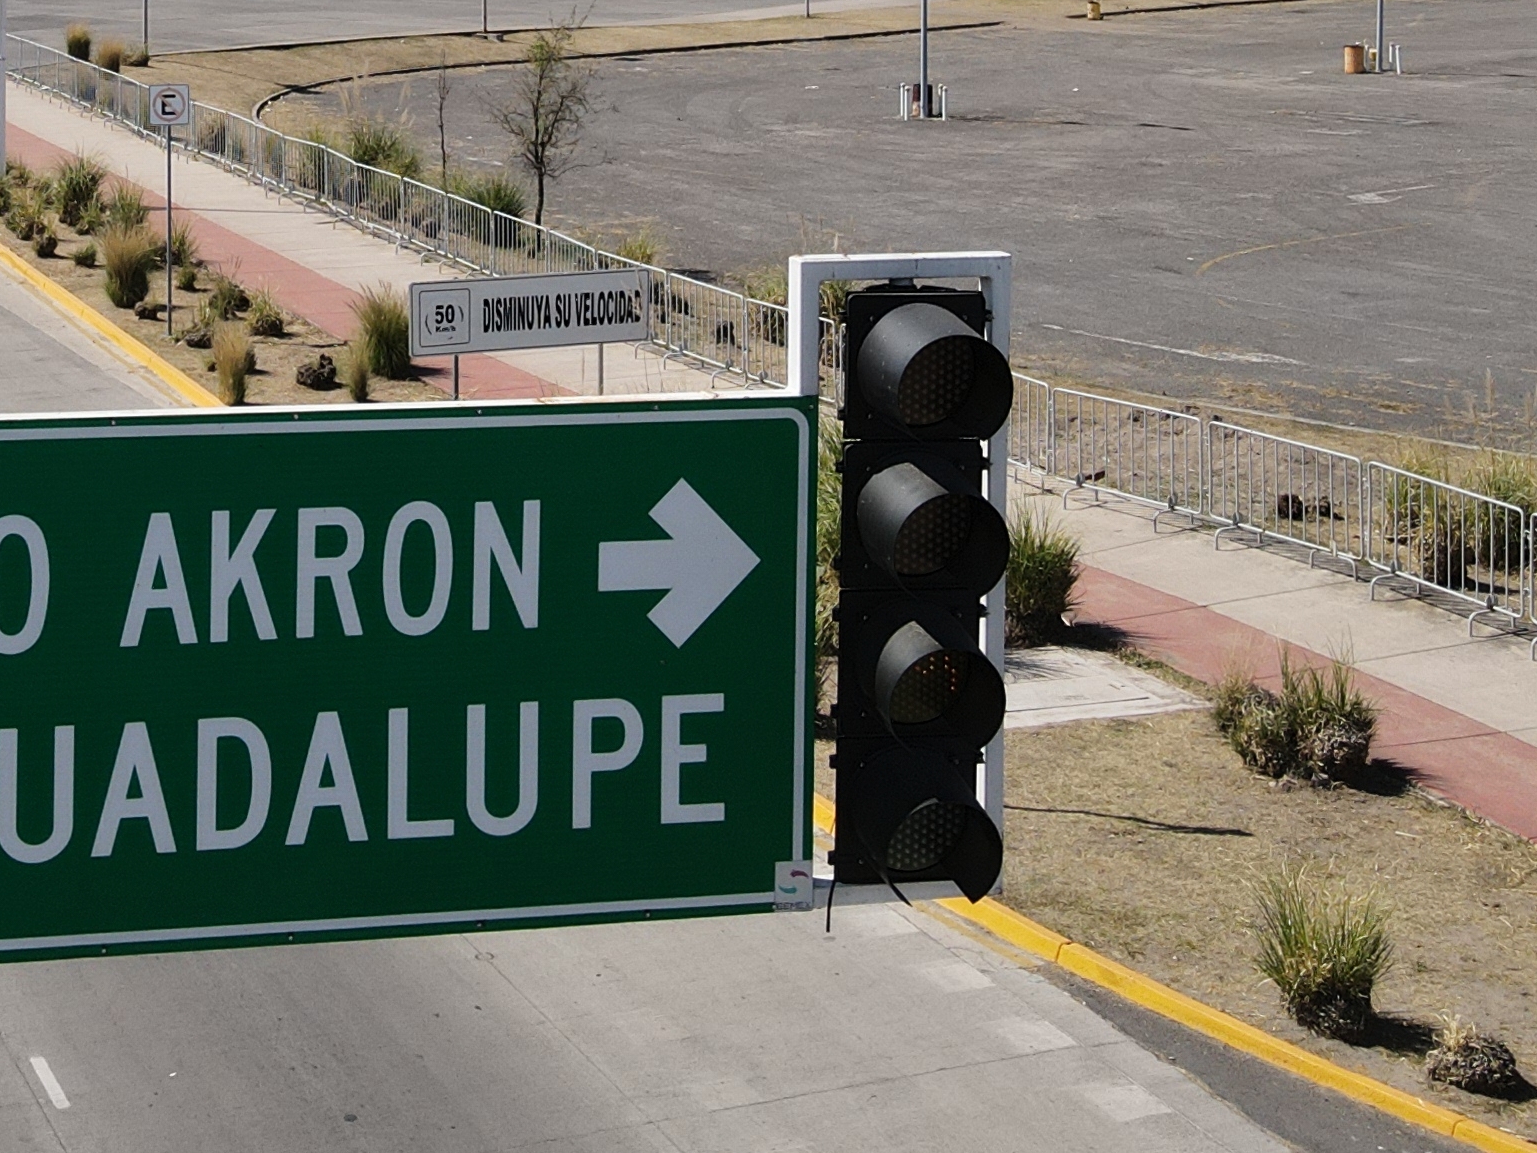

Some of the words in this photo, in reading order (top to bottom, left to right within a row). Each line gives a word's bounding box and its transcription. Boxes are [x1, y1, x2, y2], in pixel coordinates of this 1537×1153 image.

[435, 304, 455, 324] 50
[482, 295, 552, 334] DISMINUYA
[555, 293, 572, 329] SU
[119, 499, 541, 647] AKRON
